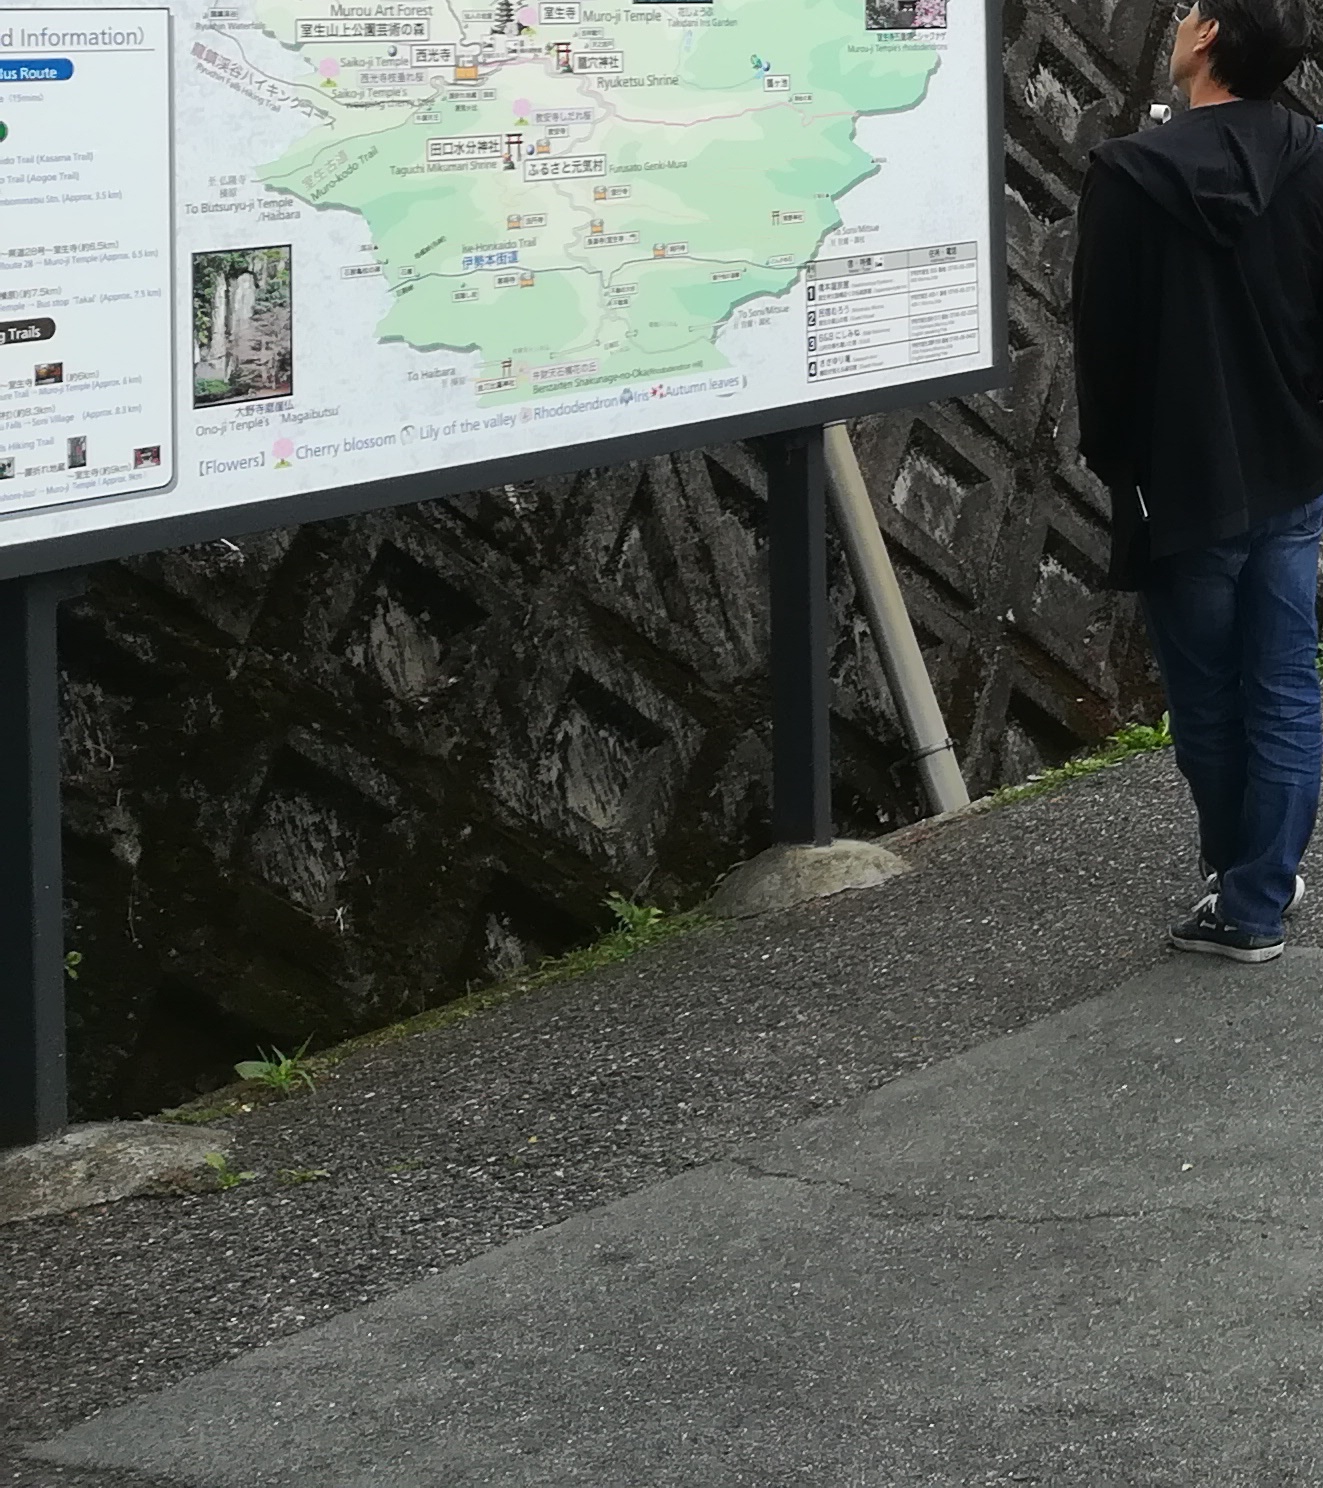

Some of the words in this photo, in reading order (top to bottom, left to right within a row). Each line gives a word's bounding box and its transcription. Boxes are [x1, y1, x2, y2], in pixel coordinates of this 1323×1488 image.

[330, 4, 371, 16] Murou
[375, 4, 395, 16] Art
[397, 5, 433, 16] Forest
[543, 7, 577, 21] 室生寺
[583, 11, 622, 23] Muro-ji
[625, 10, 662, 22] Temple
[21, 27, 144, 47] Information)
[300, 23, 425, 38] 室生山上公園芸術の森
[376, 56, 409, 68] Temple
[414, 49, 451, 63] 西光寺
[20, 68, 57, 79] Route
[597, 75, 644, 89] Ryuketsu
[646, 73, 679, 87] Shrine
[430, 140, 499, 156] 田口水分神社
[358, 146, 378, 167] Trail
[470, 160, 497, 170] Shrine
[528, 158, 603, 176] ふるさと元気村
[185, 204, 198, 214] To
[257, 198, 294, 209] Temple
[519, 237, 537, 248] Trail
[462, 251, 518, 270] 伊勢本街道
[8, 325, 41, 340] Trails
[296, 444, 340, 462] Cherry
[343, 433, 397, 452] blossom
[419, 422, 439, 440] Lily
[442, 421, 458, 435] of
[460, 417, 481, 432] the
[483, 412, 517, 432] valley
[534, 394, 619, 421] Rhododendron
[665, 382, 707, 399] Autumn
[708, 376, 739, 393] leaves
